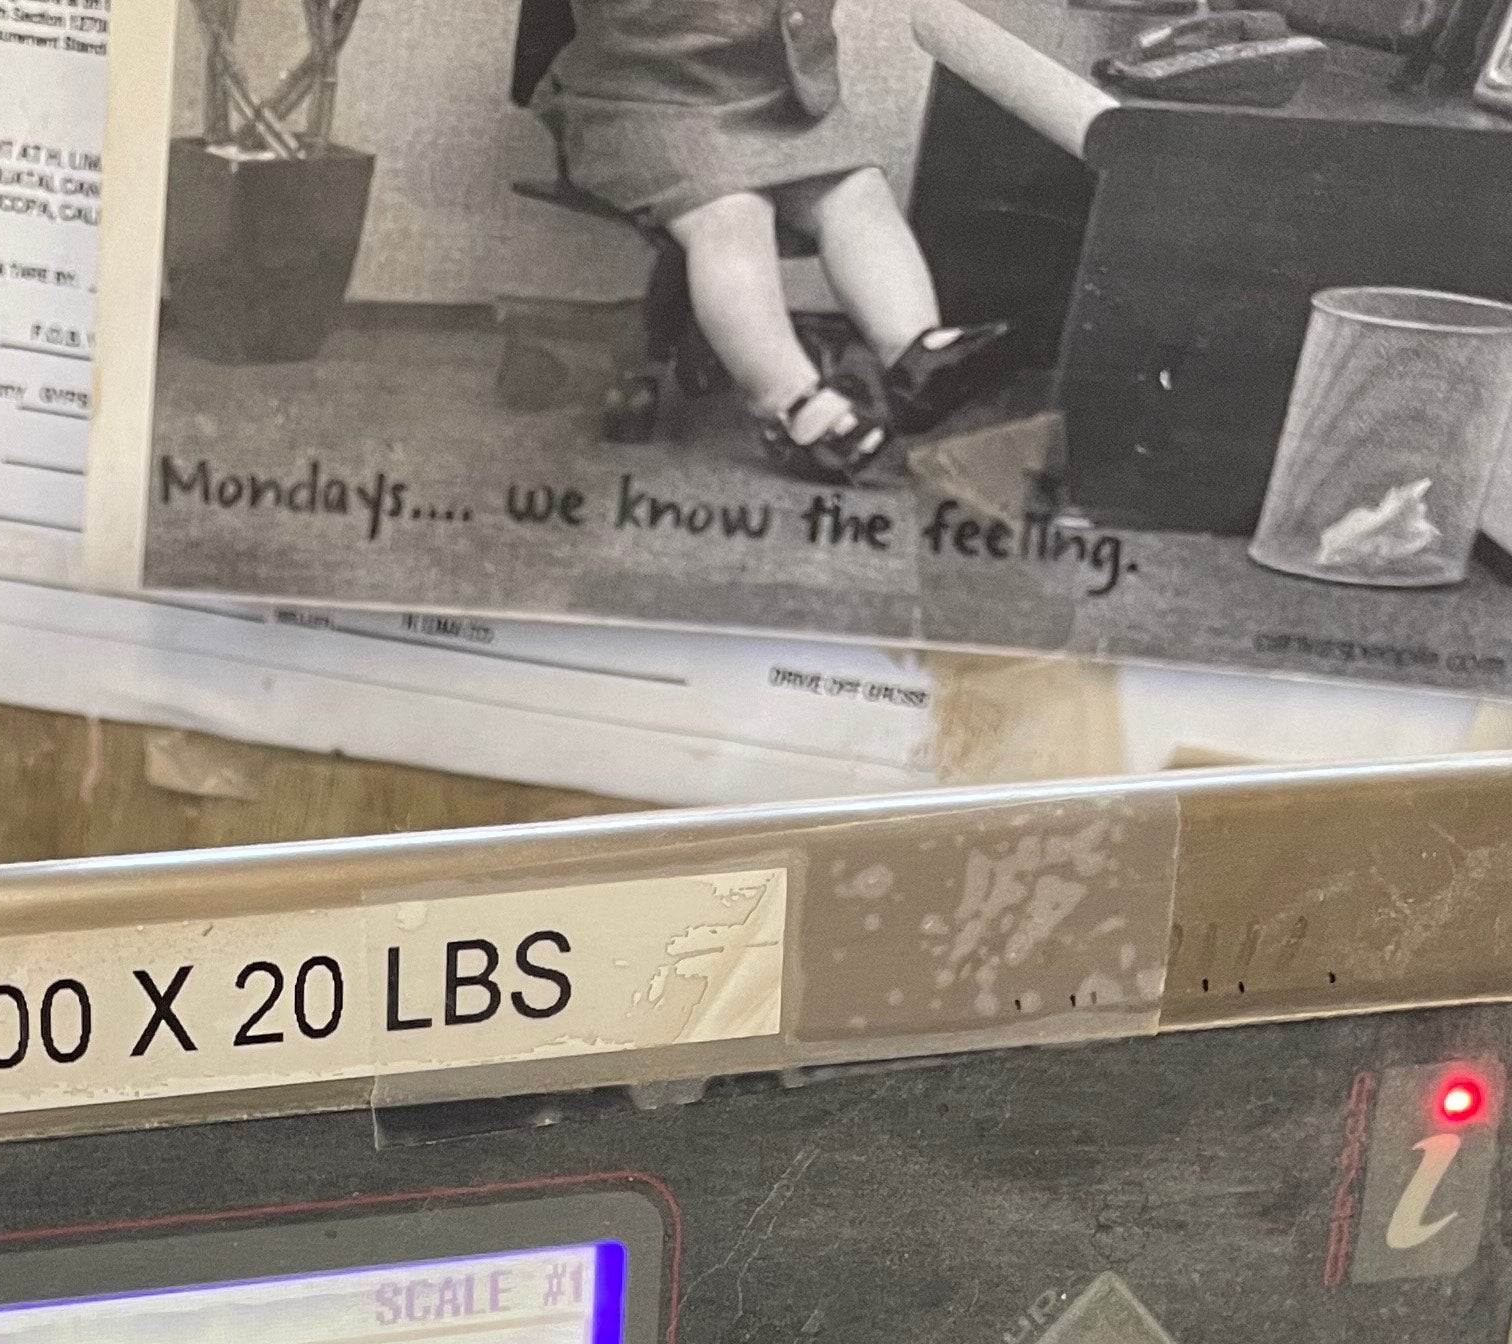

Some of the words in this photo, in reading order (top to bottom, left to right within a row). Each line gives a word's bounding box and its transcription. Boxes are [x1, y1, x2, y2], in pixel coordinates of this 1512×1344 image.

[159, 454, 473, 541] Mondays....
[505, 482, 588, 526] we
[614, 473, 771, 538] know
[801, 493, 891, 549] the
[922, 500, 1139, 594] feeling.
[130, 964, 200, 1058] X
[233, 954, 346, 1046] 20
[384, 929, 575, 1034] LBS
[375, 1267, 513, 1326] SCALE
[542, 1262, 584, 1307] #1
